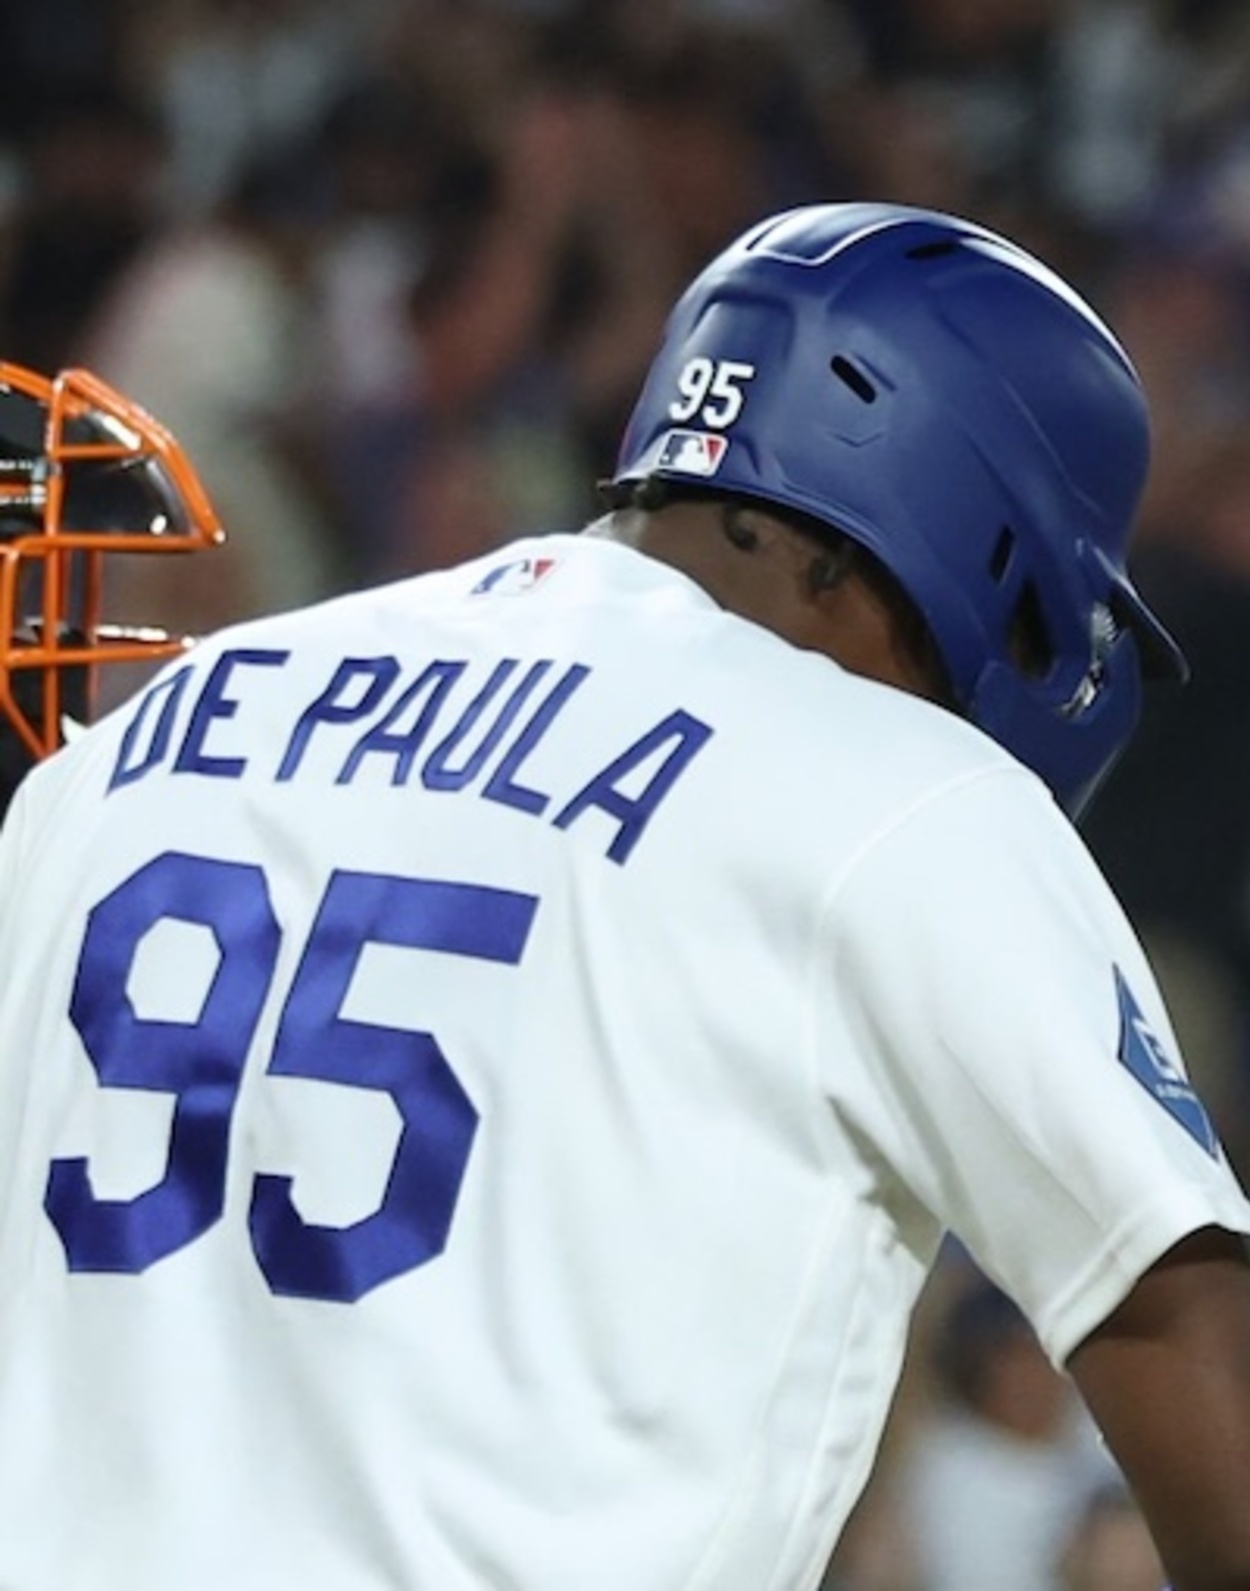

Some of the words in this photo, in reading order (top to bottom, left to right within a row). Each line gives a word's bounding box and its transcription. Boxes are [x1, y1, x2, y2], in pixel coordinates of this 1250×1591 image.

[668, 358, 754, 429] 95
[106, 648, 291, 798] DE
[275, 655, 715, 868] PAULA
[43, 849, 540, 1304] 95
